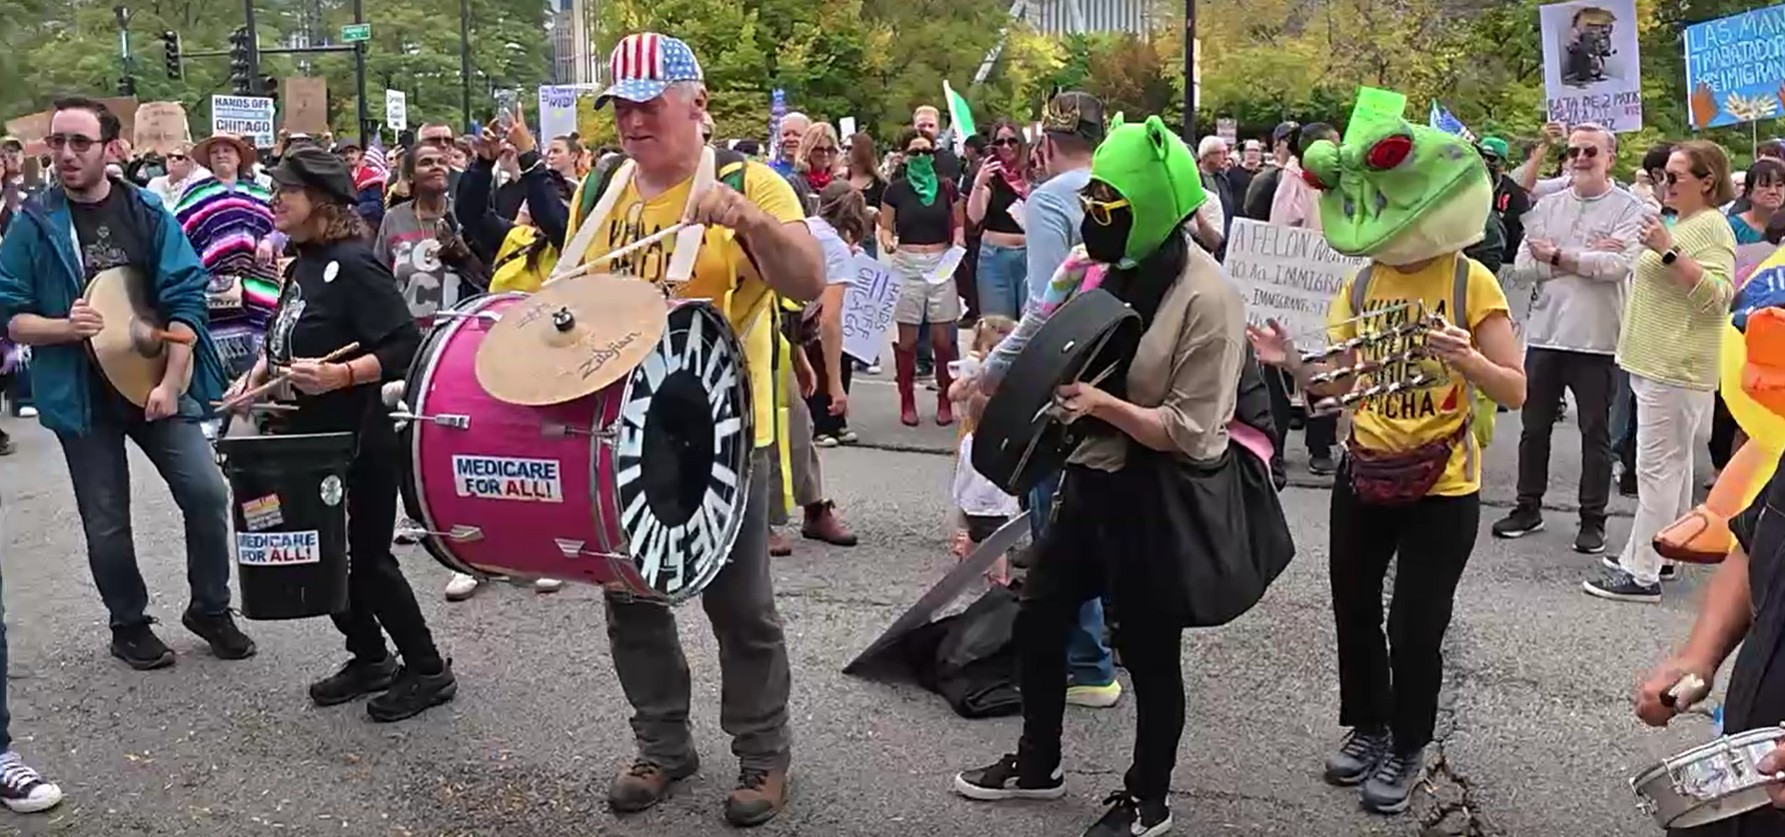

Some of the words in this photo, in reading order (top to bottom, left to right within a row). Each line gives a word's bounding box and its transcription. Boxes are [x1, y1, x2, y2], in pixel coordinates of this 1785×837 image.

[1690, 20, 1732, 52] LAS
[215, 98, 249, 108] HANDS
[252, 99, 269, 108] OFF
[1602, 93, 1611, 108] 2
[216, 119, 270, 133] CHICAGO
[1233, 223, 1244, 253] A
[1251, 225, 1310, 258] FELON
[843, 267, 874, 338] CHICAGO
[875, 282, 900, 332] HANDS
[860, 304, 878, 340] OFF
[578, 330, 643, 381] Zildjian
[457, 458, 556, 480] MEDICARE
[465, 478, 503, 495] FOR
[506, 480, 552, 499] ALL!
[239, 533, 316, 549] MEDICARE
[241, 550, 266, 562] FOR
[270, 547, 311, 562] ALL!
